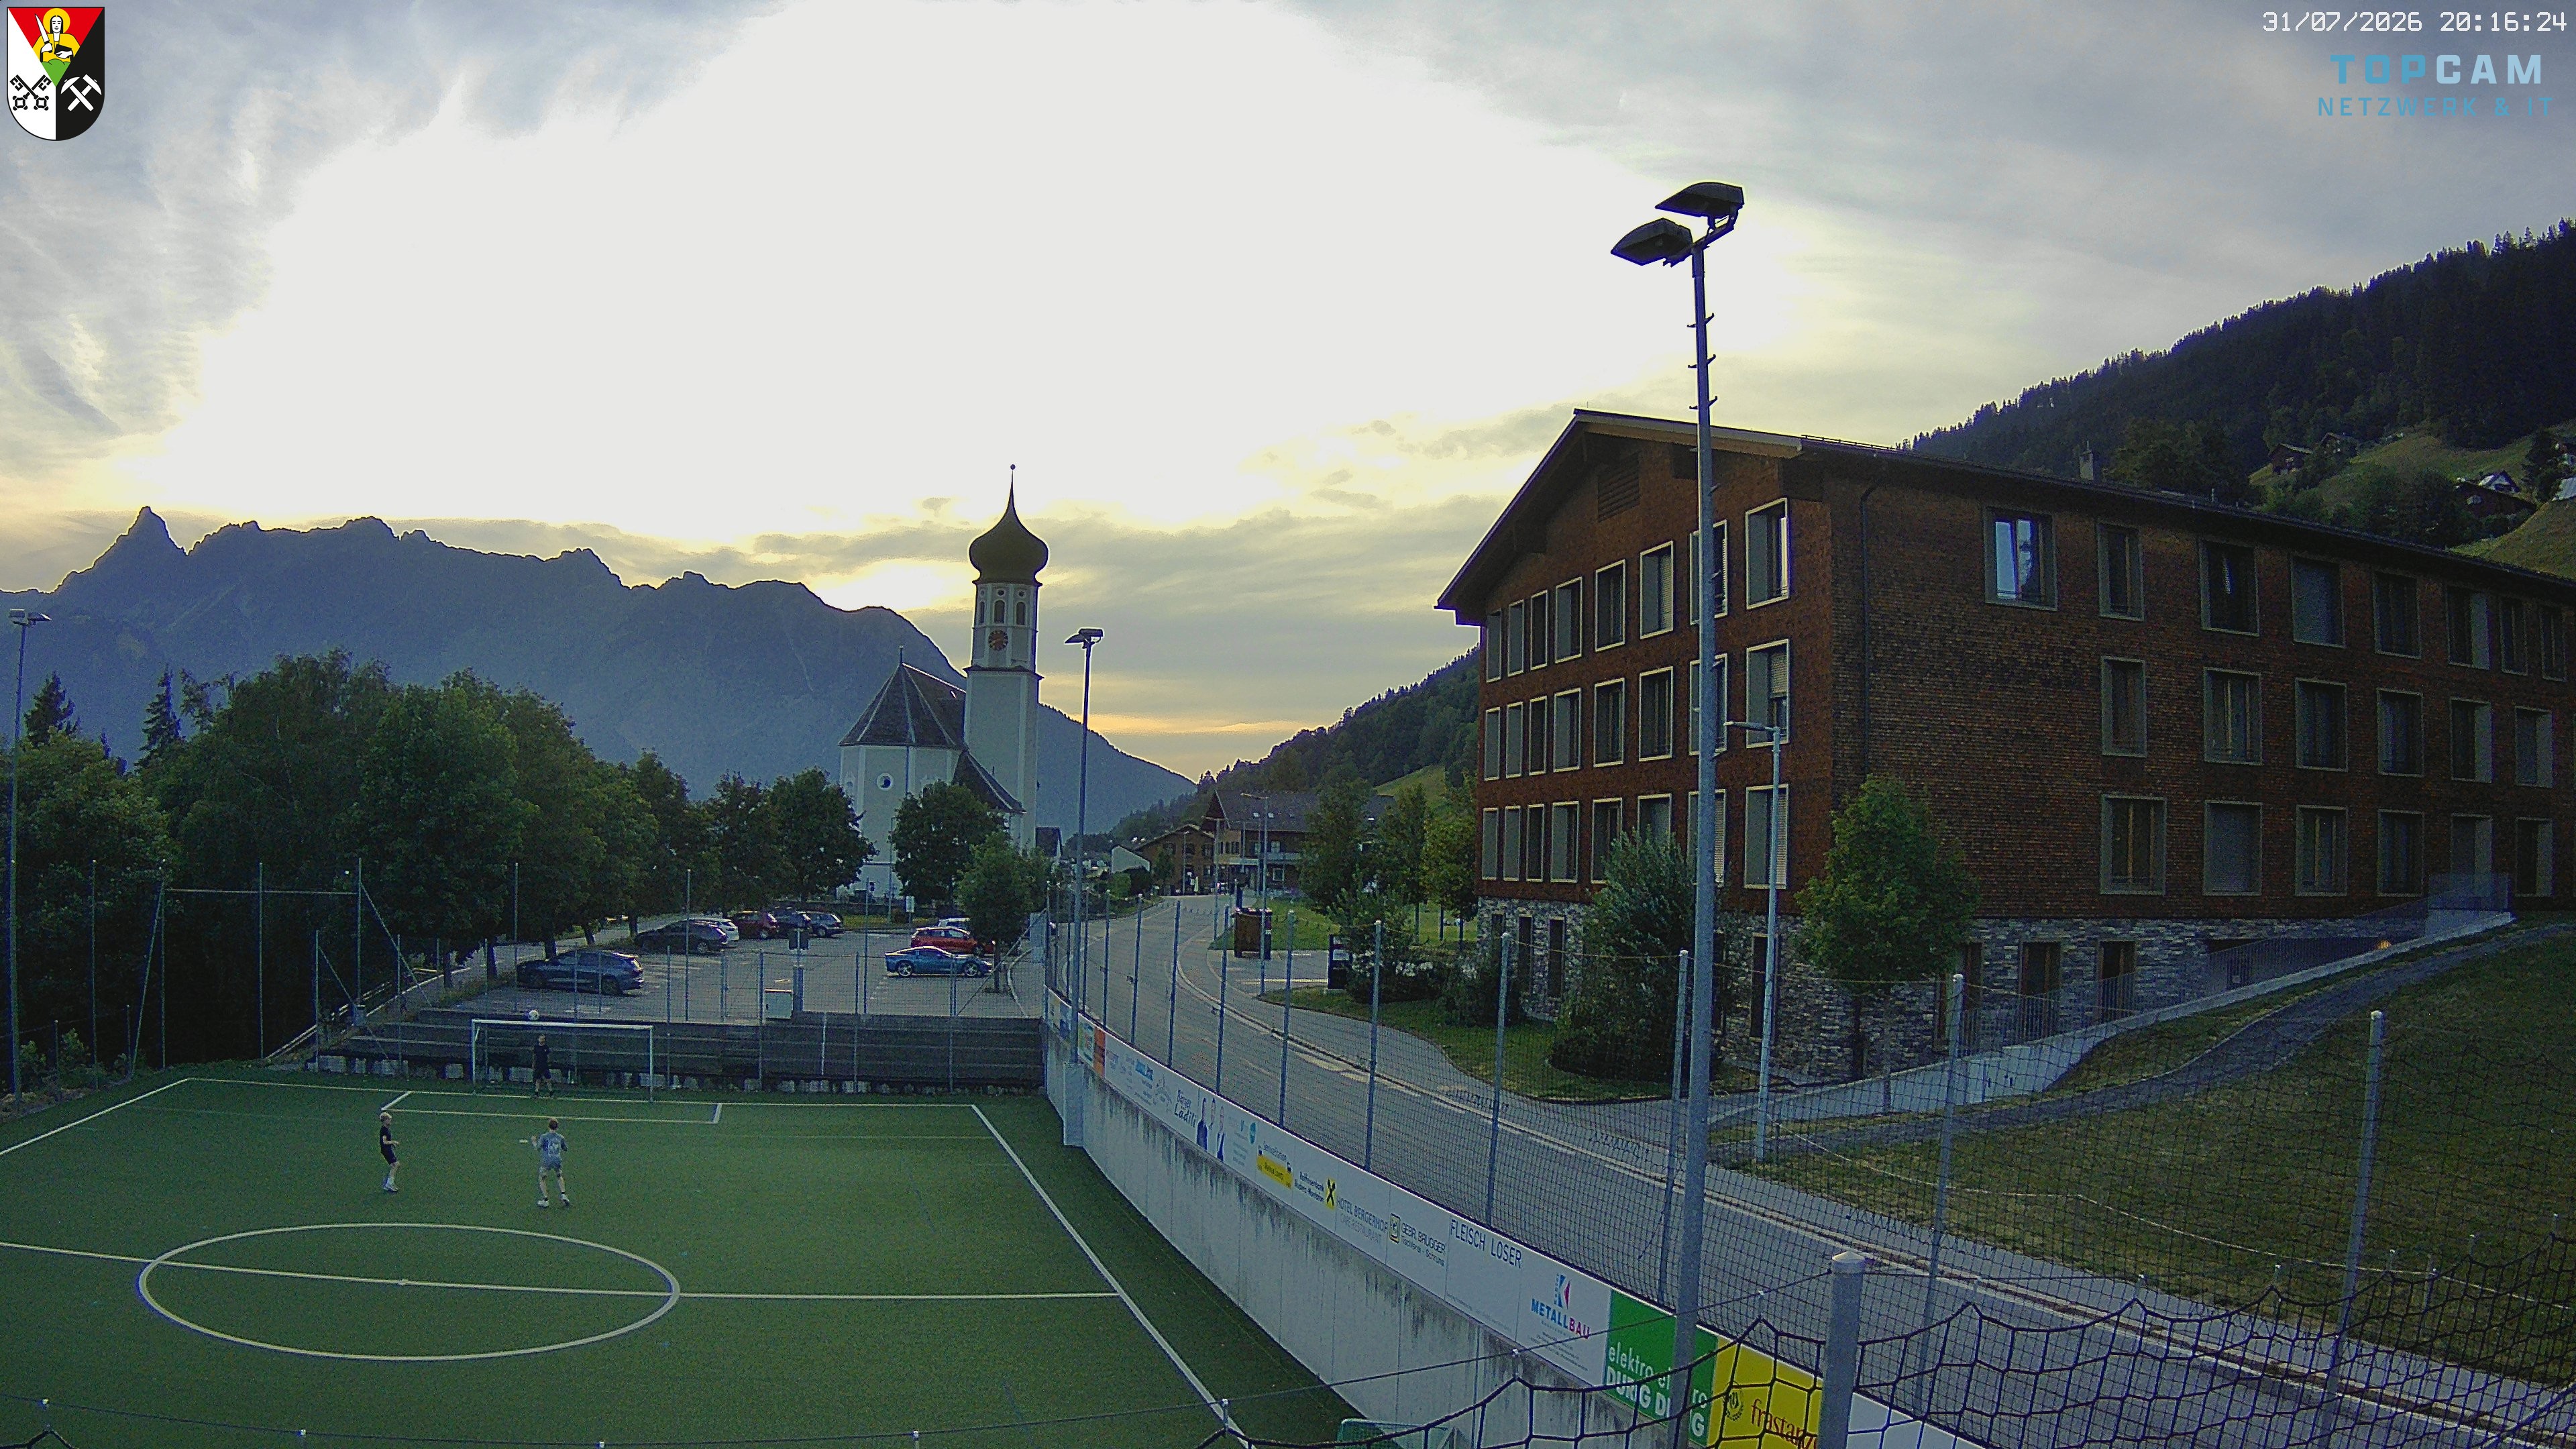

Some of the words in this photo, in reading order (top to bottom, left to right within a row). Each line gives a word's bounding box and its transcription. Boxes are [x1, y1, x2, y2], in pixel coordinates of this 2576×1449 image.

[1450, 1219, 1486, 1252] FLEISCH
[1491, 1238, 1521, 1269] LOSER
[1532, 1298, 1590, 1339] METALLBAU
[1609, 1341, 1654, 1378] elektro
